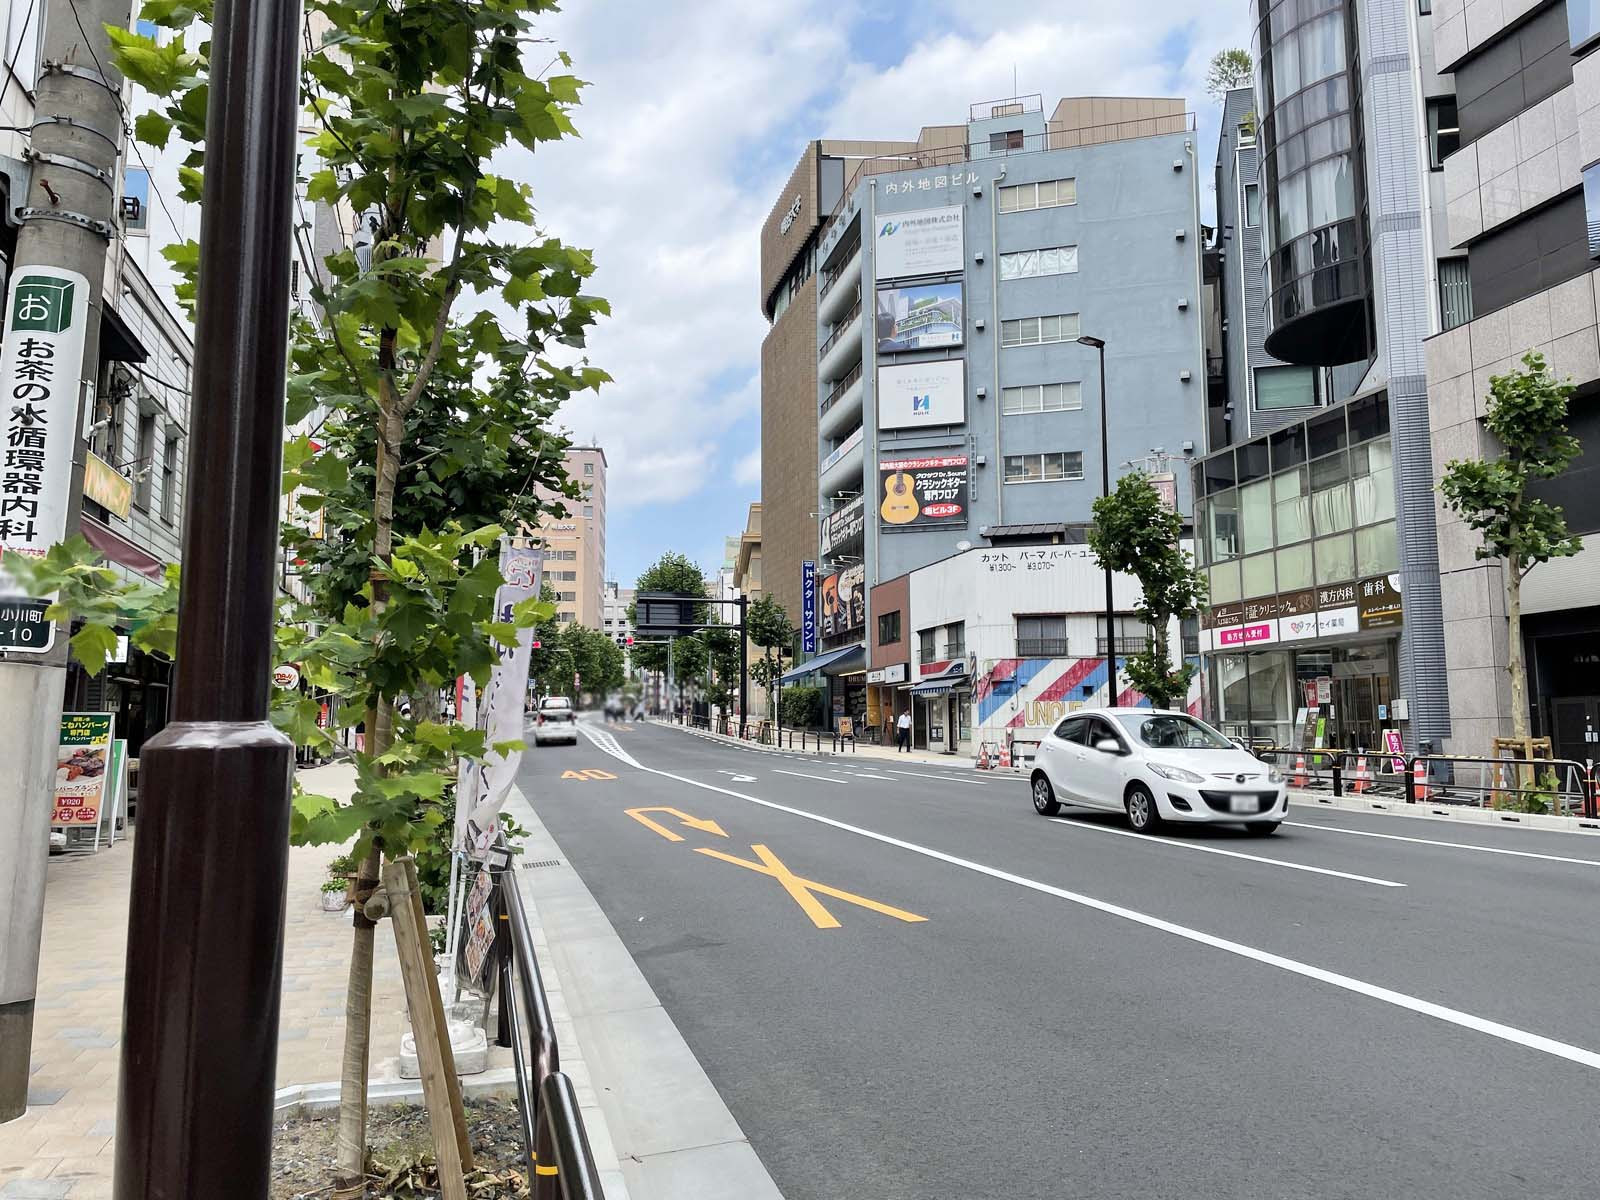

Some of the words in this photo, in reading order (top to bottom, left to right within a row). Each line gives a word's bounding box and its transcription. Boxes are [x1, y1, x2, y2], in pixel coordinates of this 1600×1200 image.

[886, 172, 979, 194] 内外地図ビル
[19, 293, 51, 320] お
[0, 338, 55, 542] お茶の水循環器内科
[916, 478, 966, 490] クラシックギター
[924, 489, 958, 501] 専門フロア
[982, 553, 1009, 562] カット
[1320, 586, 1354, 603] 漢方内科
[1364, 580, 1386, 597] 歯科
[1, 608, 43, 623] 小川町
[804, 569, 814, 651] ドクターサウンド
[1306, 617, 1344, 631] アイセイ薬局
[1227, 629, 1263, 641] 処方せん受付
[561, 769, 618, 780] 40
